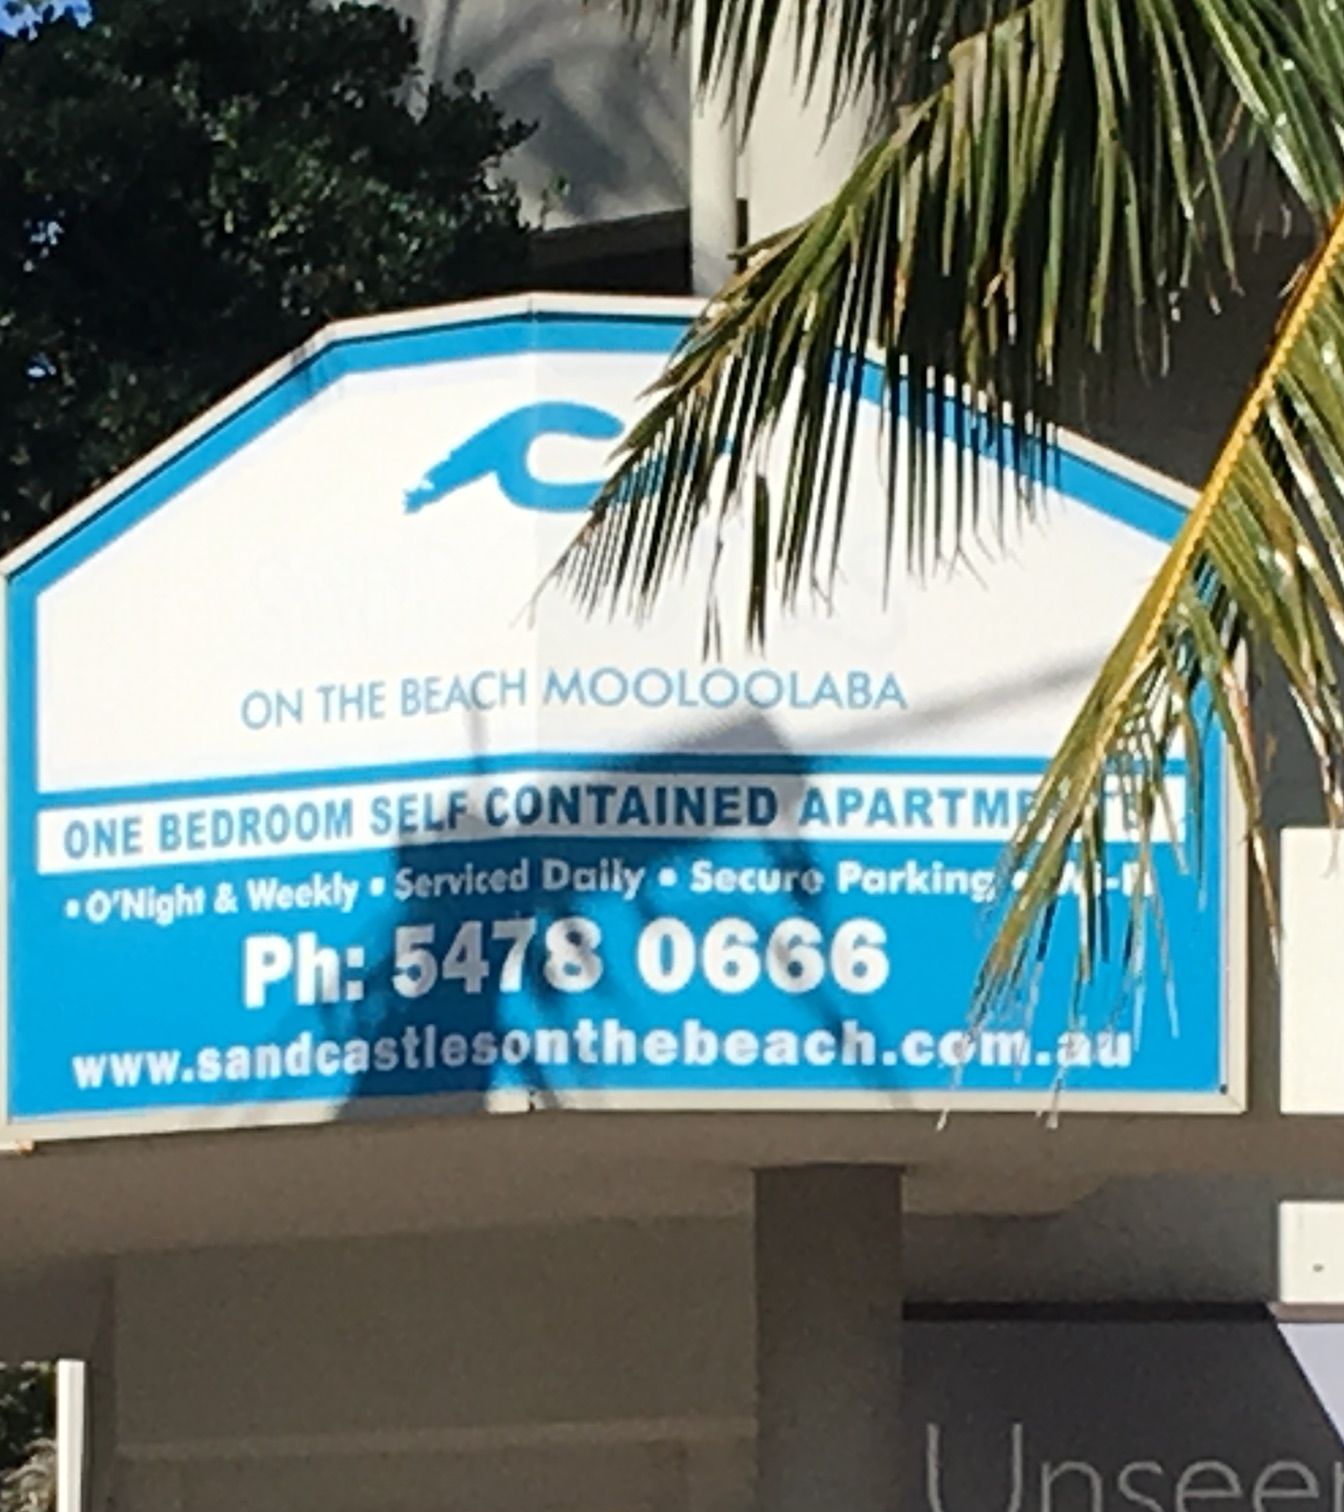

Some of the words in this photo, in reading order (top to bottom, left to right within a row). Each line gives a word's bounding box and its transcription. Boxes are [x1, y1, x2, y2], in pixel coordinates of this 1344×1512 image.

[241, 689, 303, 729] ON
[316, 682, 385, 722] THE
[401, 668, 527, 717] BEACH
[544, 667, 908, 711] MOOLOOLABA
[63, 817, 142, 860] ONE
[159, 804, 354, 853] BEDROOM
[370, 790, 468, 838] SELF
[485, 784, 778, 827] CONTAINED
[86, 886, 204, 925] O'Night
[214, 887, 240, 915] &
[246, 873, 358, 915] Weekly
[394, 860, 528, 901] Serviced
[542, 858, 645, 901] Daily
[691, 860, 825, 896] Secure
[837, 860, 996, 902] Parking
[243, 931, 366, 1010] Ph:
[392, 915, 603, 1000] 5478
[636, 916, 890, 995] 0666
[71, 1018, 1132, 1089] www.sandcastlesonthebeach.com.au
